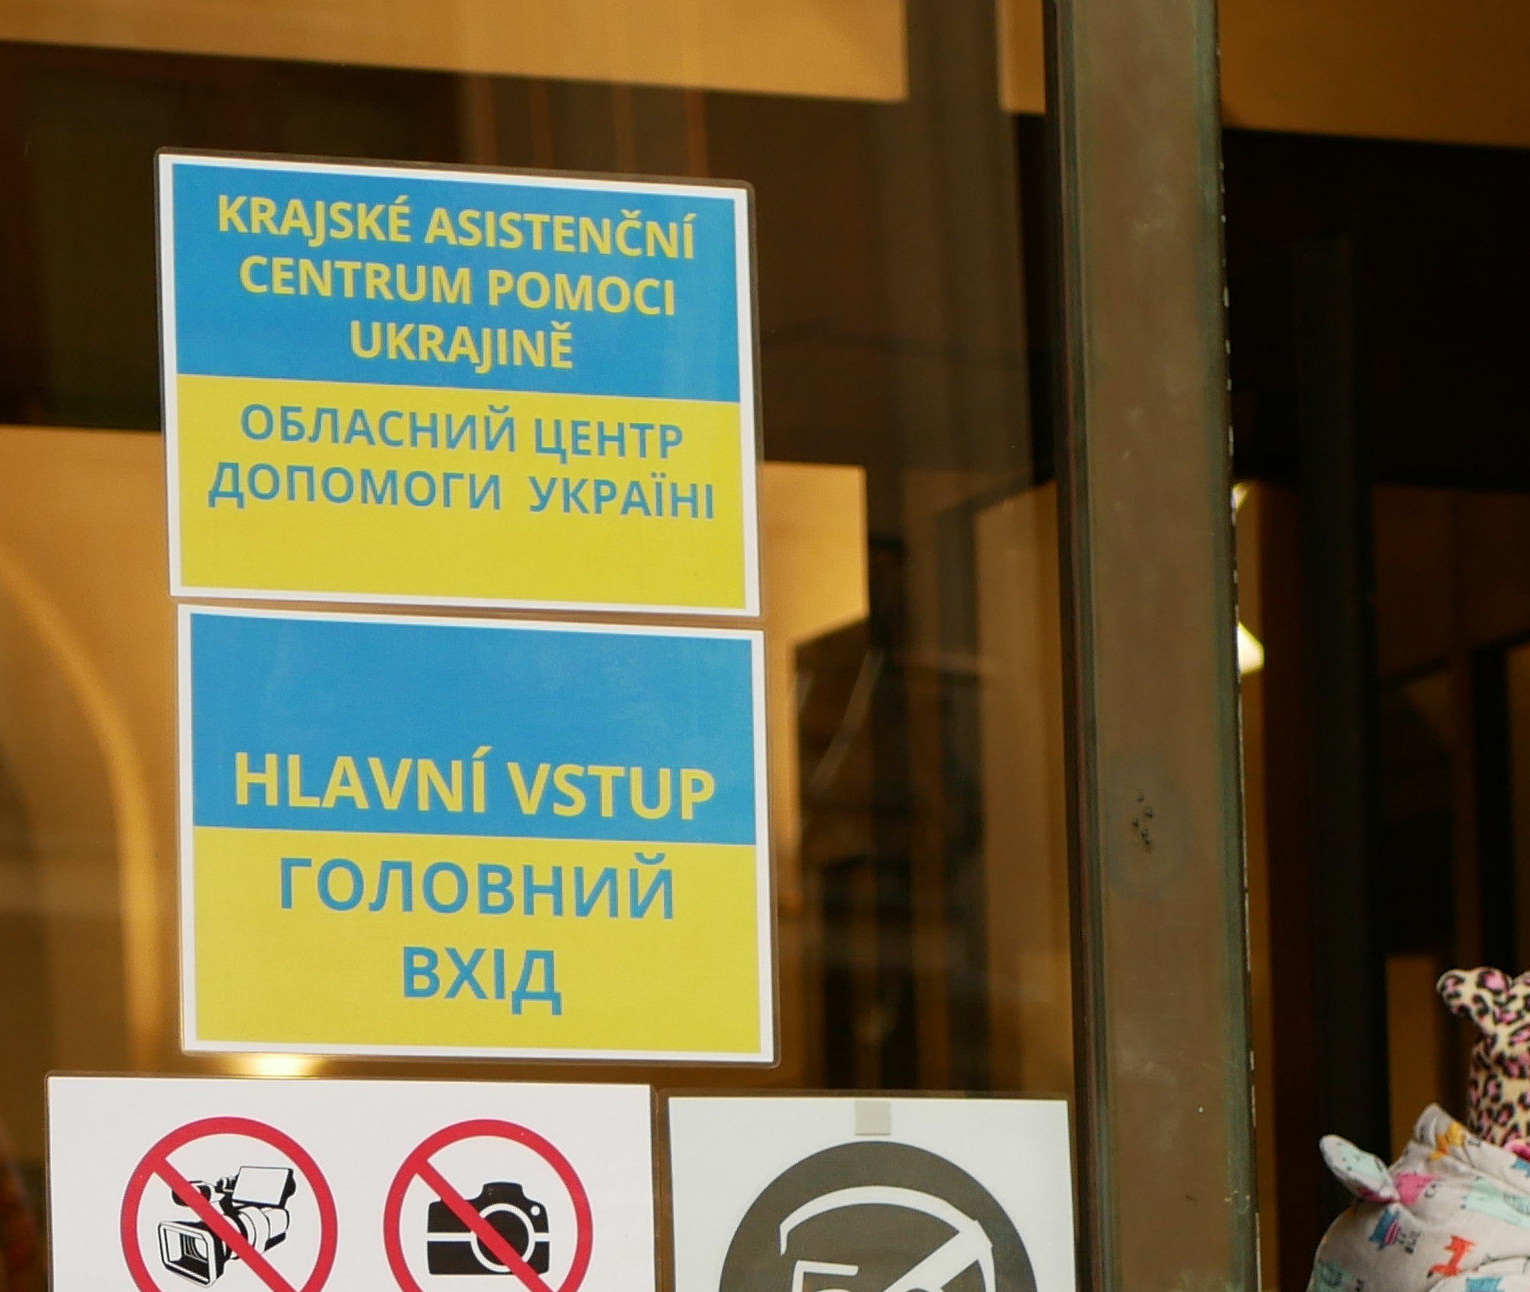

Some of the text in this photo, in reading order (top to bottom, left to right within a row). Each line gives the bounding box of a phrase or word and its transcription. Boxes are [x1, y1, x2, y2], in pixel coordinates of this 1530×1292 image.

[217, 194, 697, 259] KRAJSKÉ ASISTENČNÍ
[239, 255, 675, 316] CENTRUM POMOCI
[349, 319, 573, 374] UKRAJINĚ
[240, 403, 684, 465] ОБЛАСНИЙ ЦЕНТР
[207, 461, 716, 520] ДОПОМОГИ УКРАЇНІ
[234, 745, 716, 820] HLAVNÍ VSTUP
[280, 852, 675, 920] ГОЛОВНИЙ
[402, 945, 563, 1016] ВХІД
